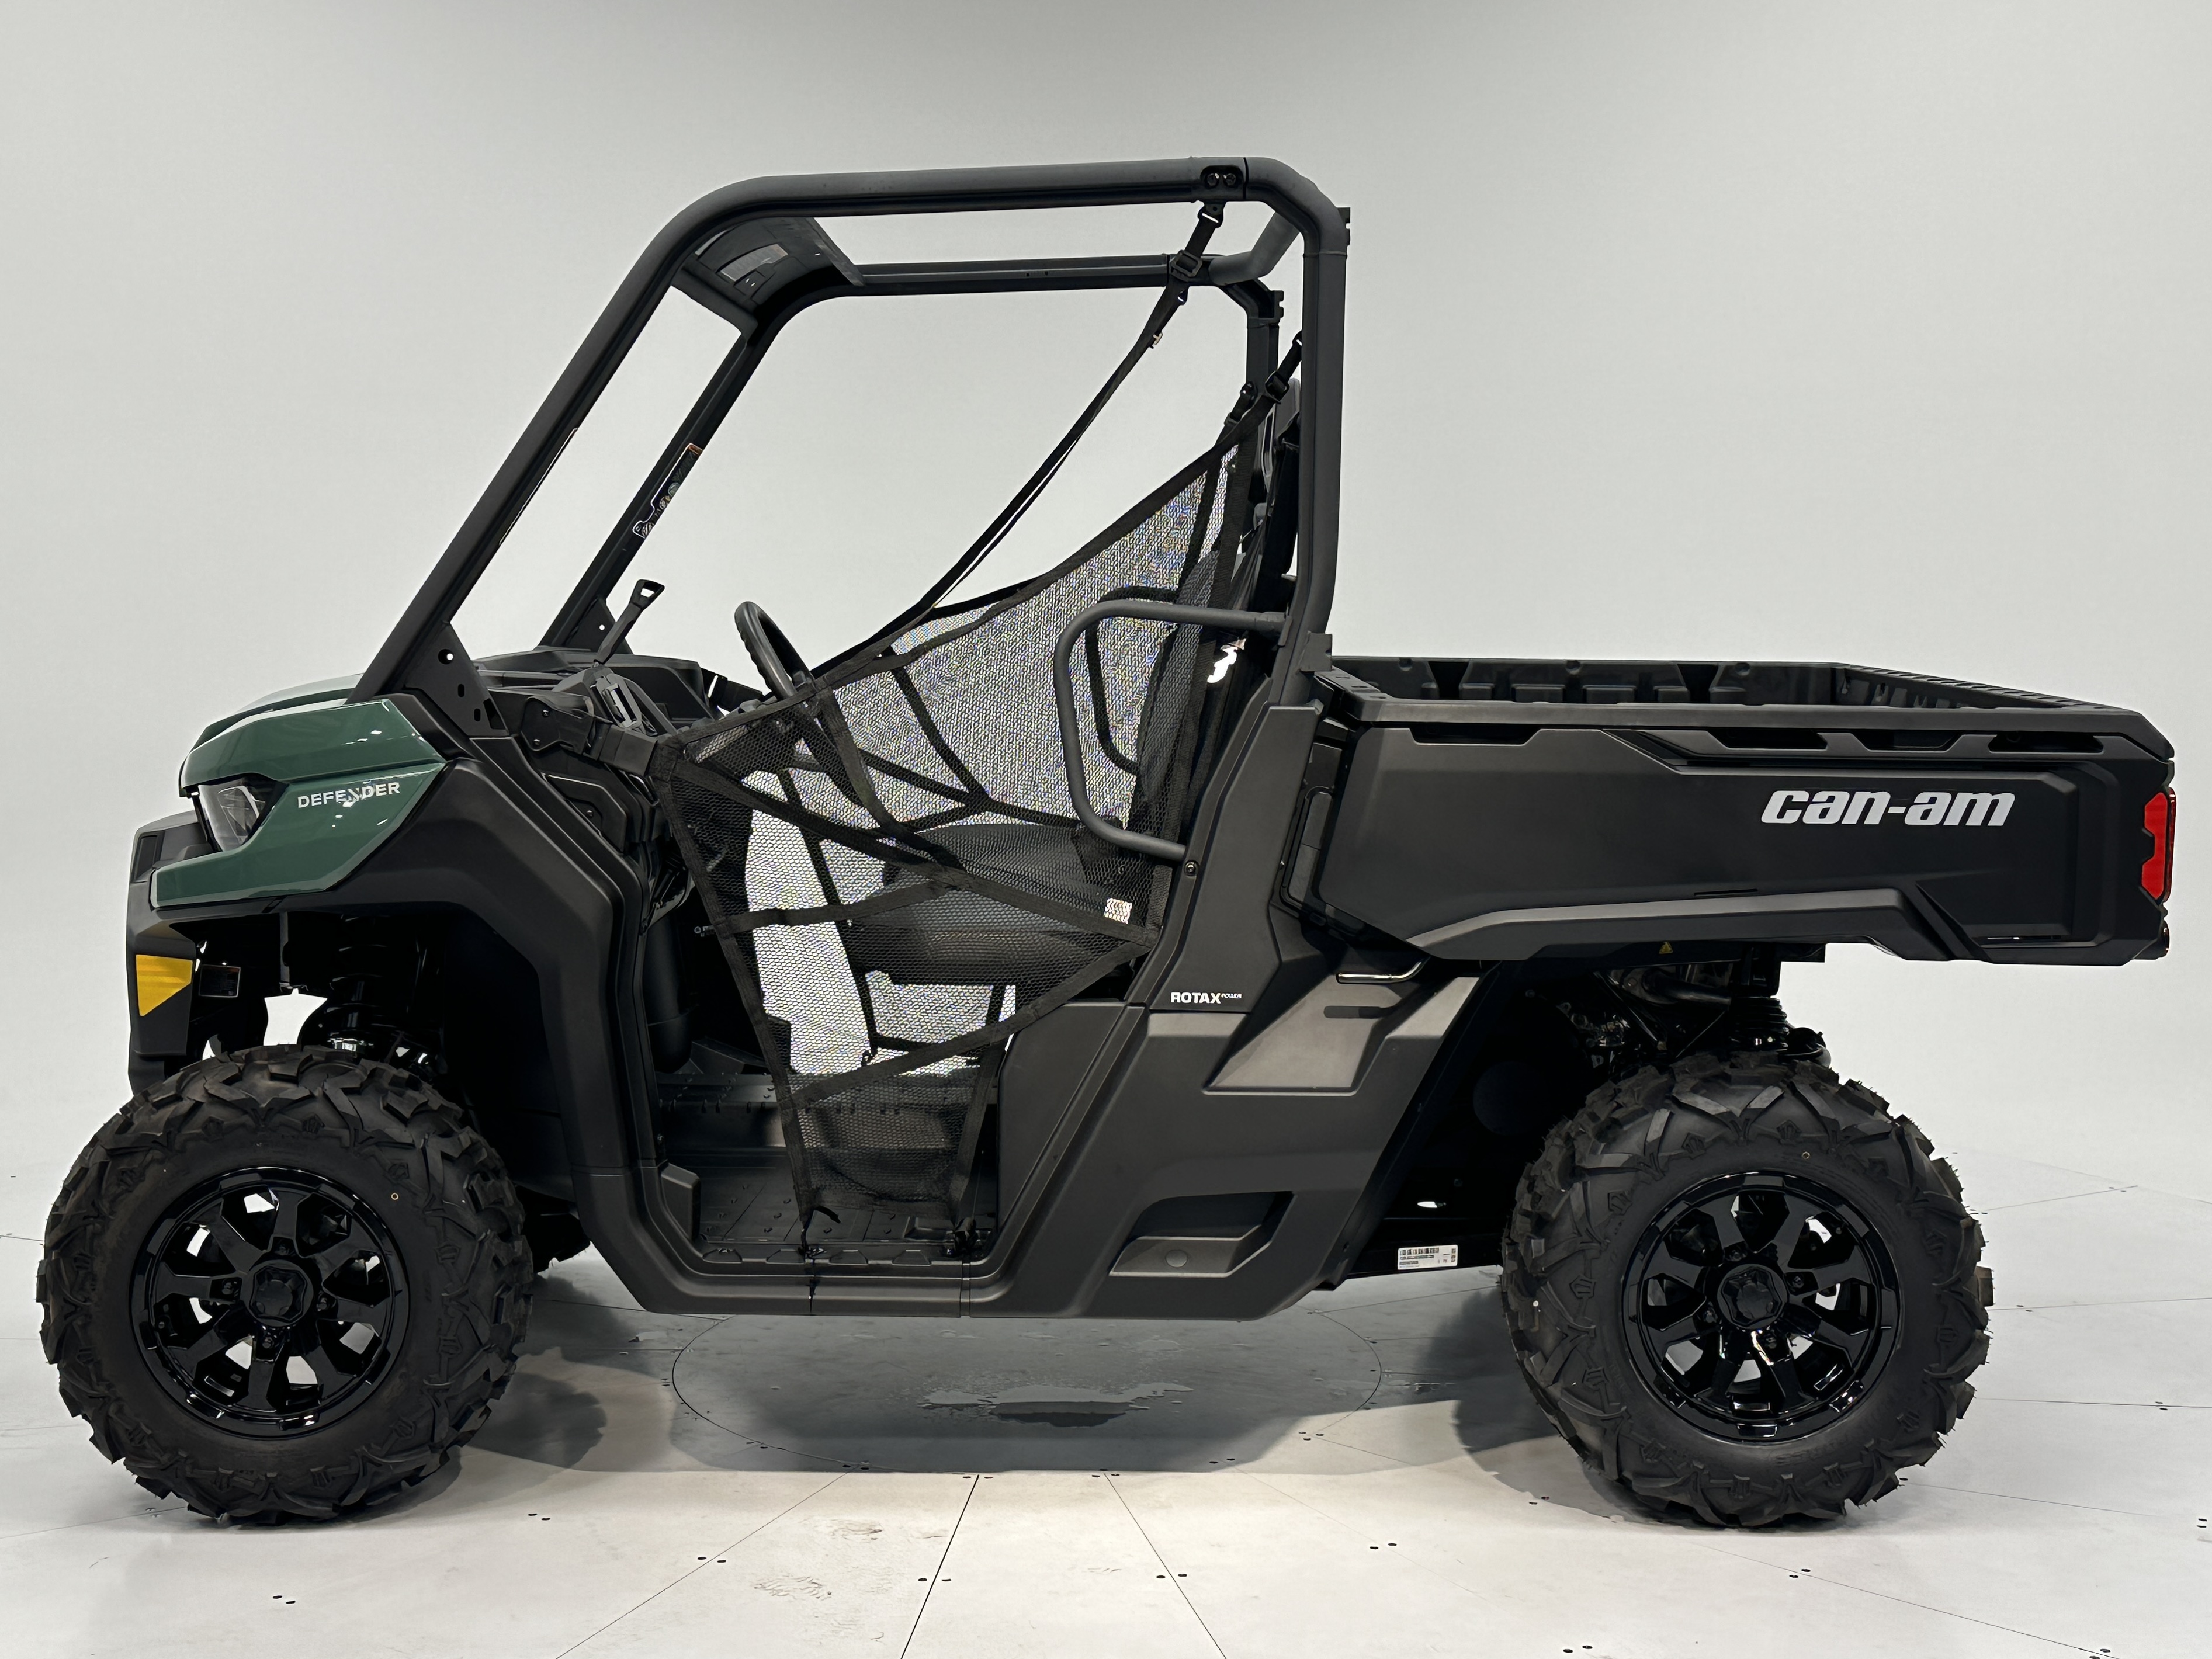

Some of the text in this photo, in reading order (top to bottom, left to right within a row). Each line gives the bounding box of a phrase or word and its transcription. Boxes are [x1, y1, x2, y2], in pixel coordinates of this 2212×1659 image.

[297, 782, 400, 808] DEFENDER
[1761, 790, 2016, 826] can-am
[1170, 992, 1221, 1004] ROTAX
